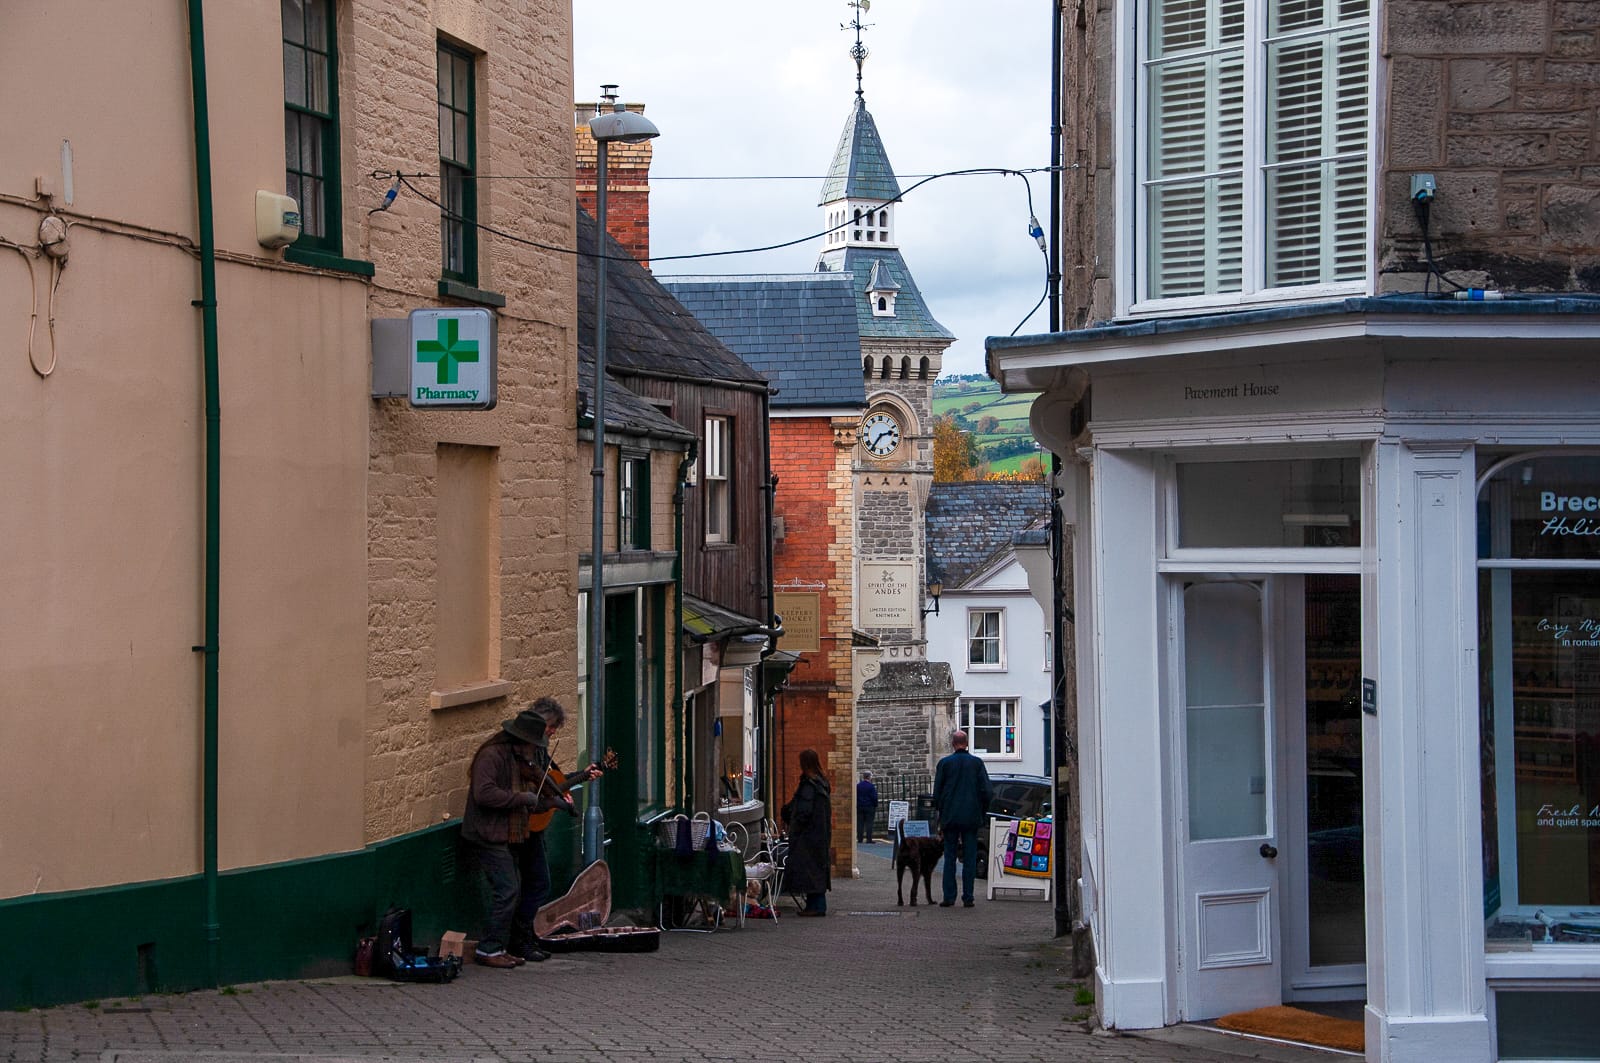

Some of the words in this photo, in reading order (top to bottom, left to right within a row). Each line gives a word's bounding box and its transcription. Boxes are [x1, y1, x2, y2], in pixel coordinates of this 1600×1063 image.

[416, 387, 479, 401] Pharmacy
[1184, 385, 1240, 400] Pavement
[1243, 383, 1280, 397] House
[1541, 491, 1600, 512] Brec
[1536, 618, 1570, 639] Cosy
[1562, 639, 1570, 647] in
[1537, 804, 1581, 816] Fresh
[1537, 817, 1554, 826] and
[1557, 818, 1578, 828] quiet
